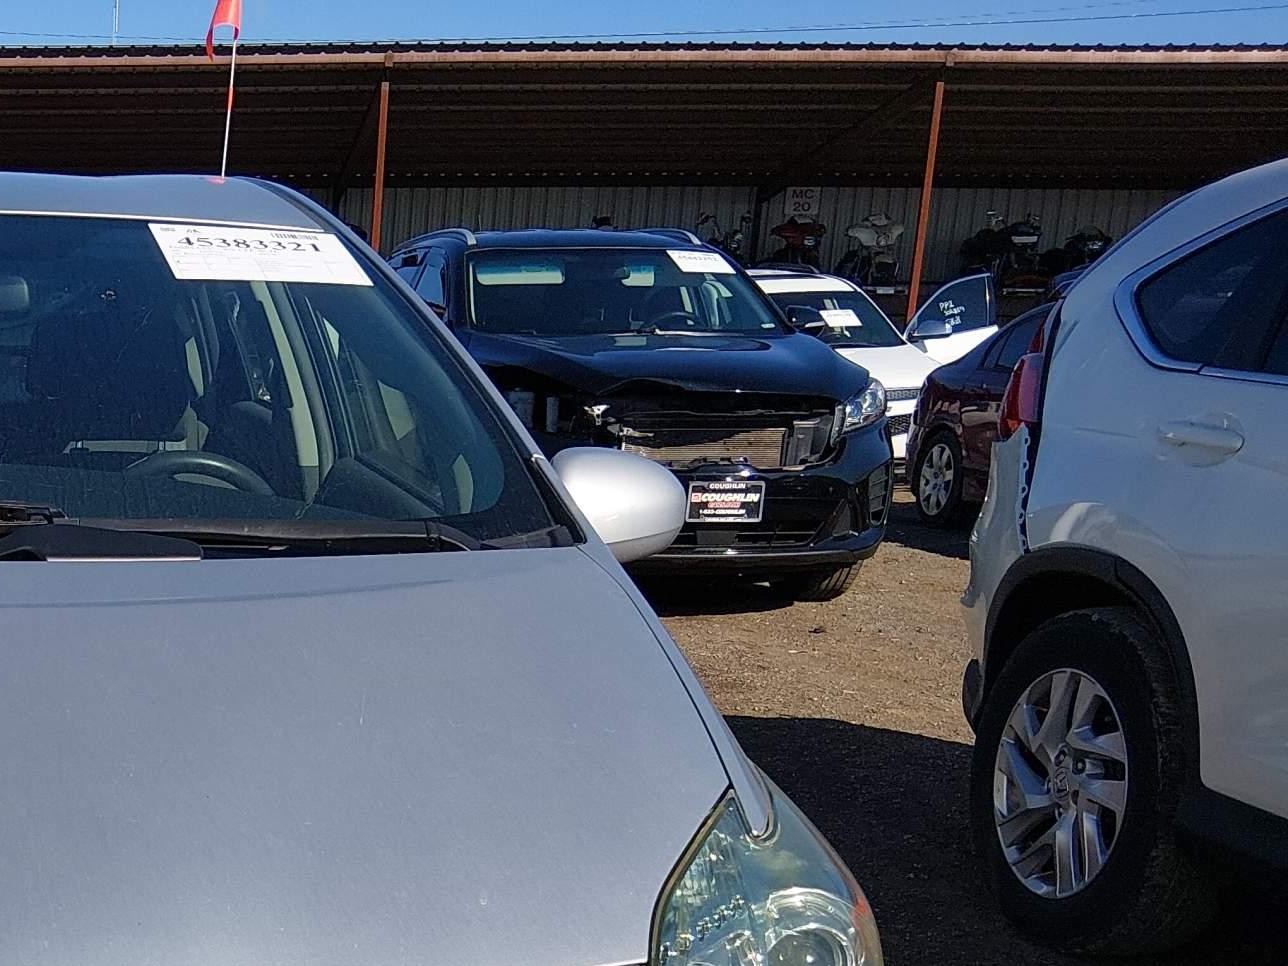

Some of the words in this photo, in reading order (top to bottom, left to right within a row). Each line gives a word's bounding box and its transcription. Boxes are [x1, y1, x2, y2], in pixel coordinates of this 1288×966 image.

[791, 188, 815, 200] MC
[792, 201, 811, 212] 20
[177, 236, 321, 252] 45383321
[702, 493, 760, 502] COUGHLIN
